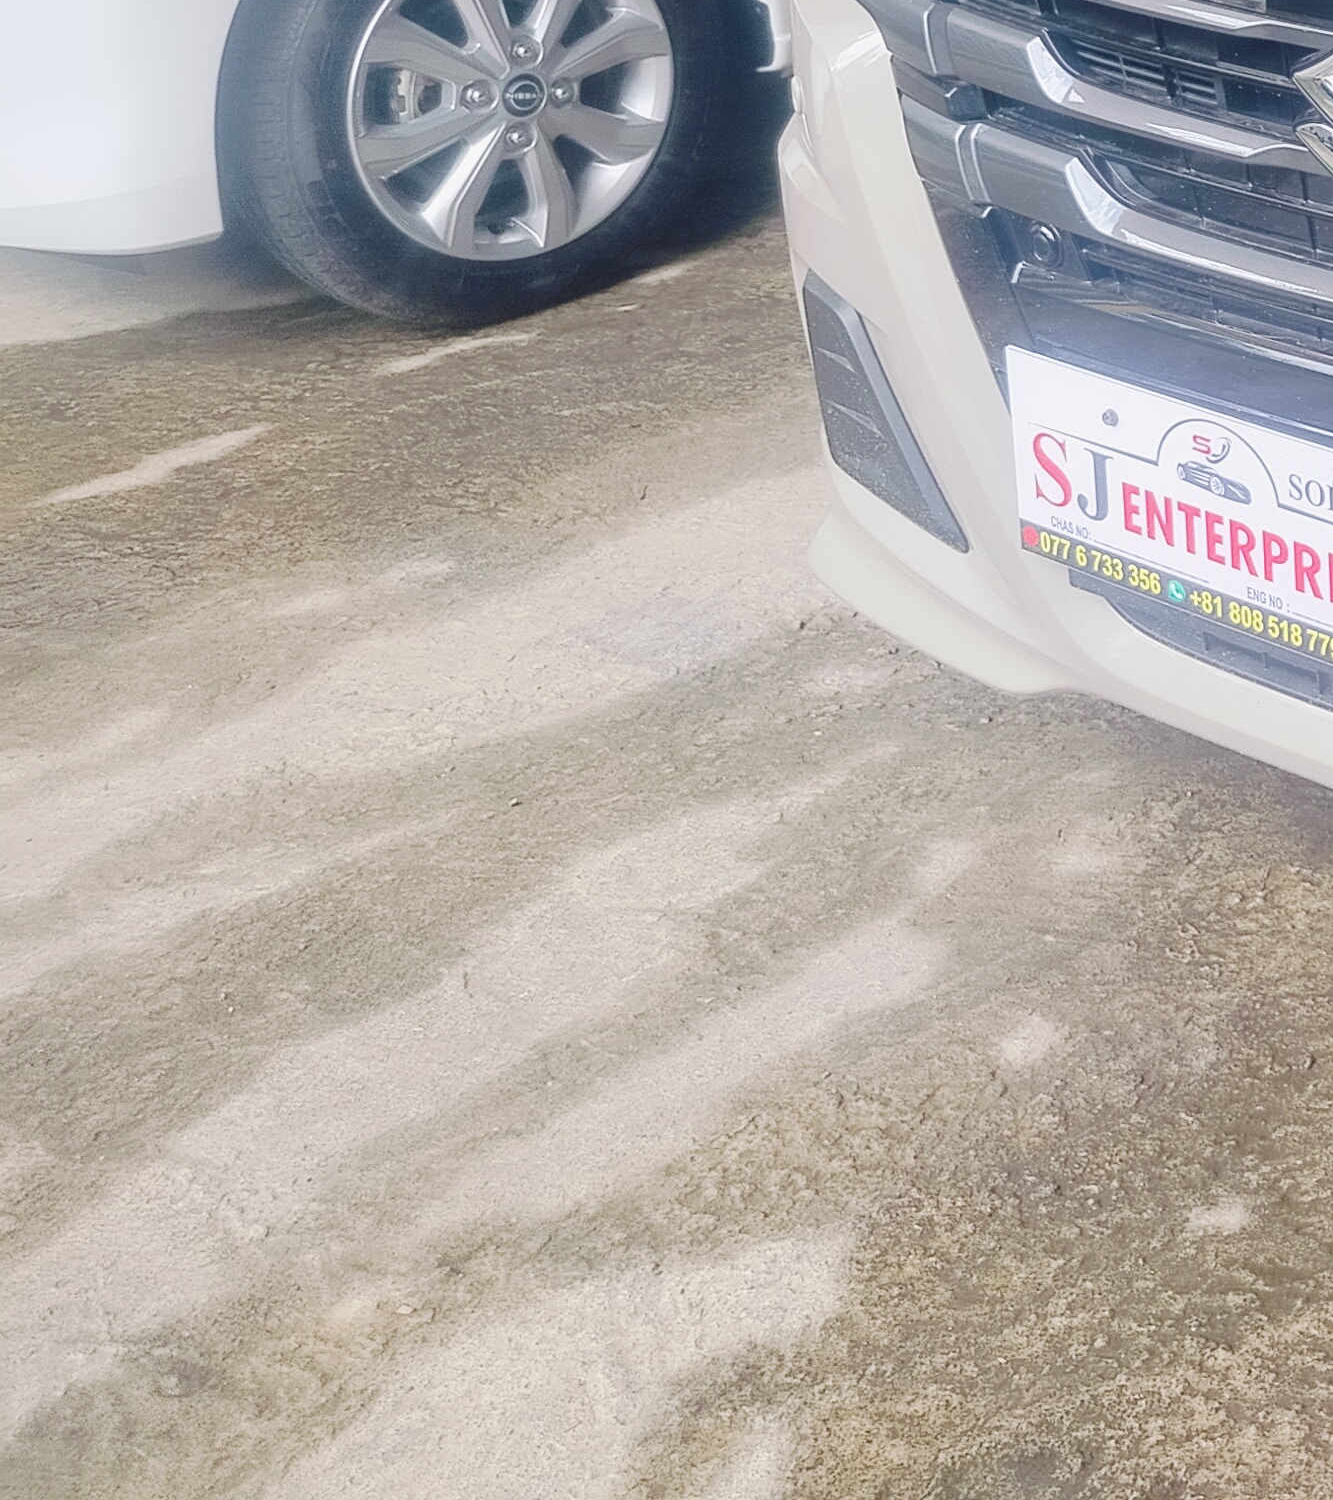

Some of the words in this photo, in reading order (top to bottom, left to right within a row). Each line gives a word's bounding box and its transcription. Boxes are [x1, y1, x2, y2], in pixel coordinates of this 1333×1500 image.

[1050, 515, 1074, 535] CHAS
[1039, 531, 1071, 560] 077
[1075, 544, 1088, 567] 6
[1091, 549, 1124, 581] 733
[1128, 564, 1161, 595] 356
[1190, 590, 1222, 618] +81
[1229, 601, 1264, 633] 808
[1267, 615, 1303, 647] 518
[1247, 586, 1267, 605] ENG
